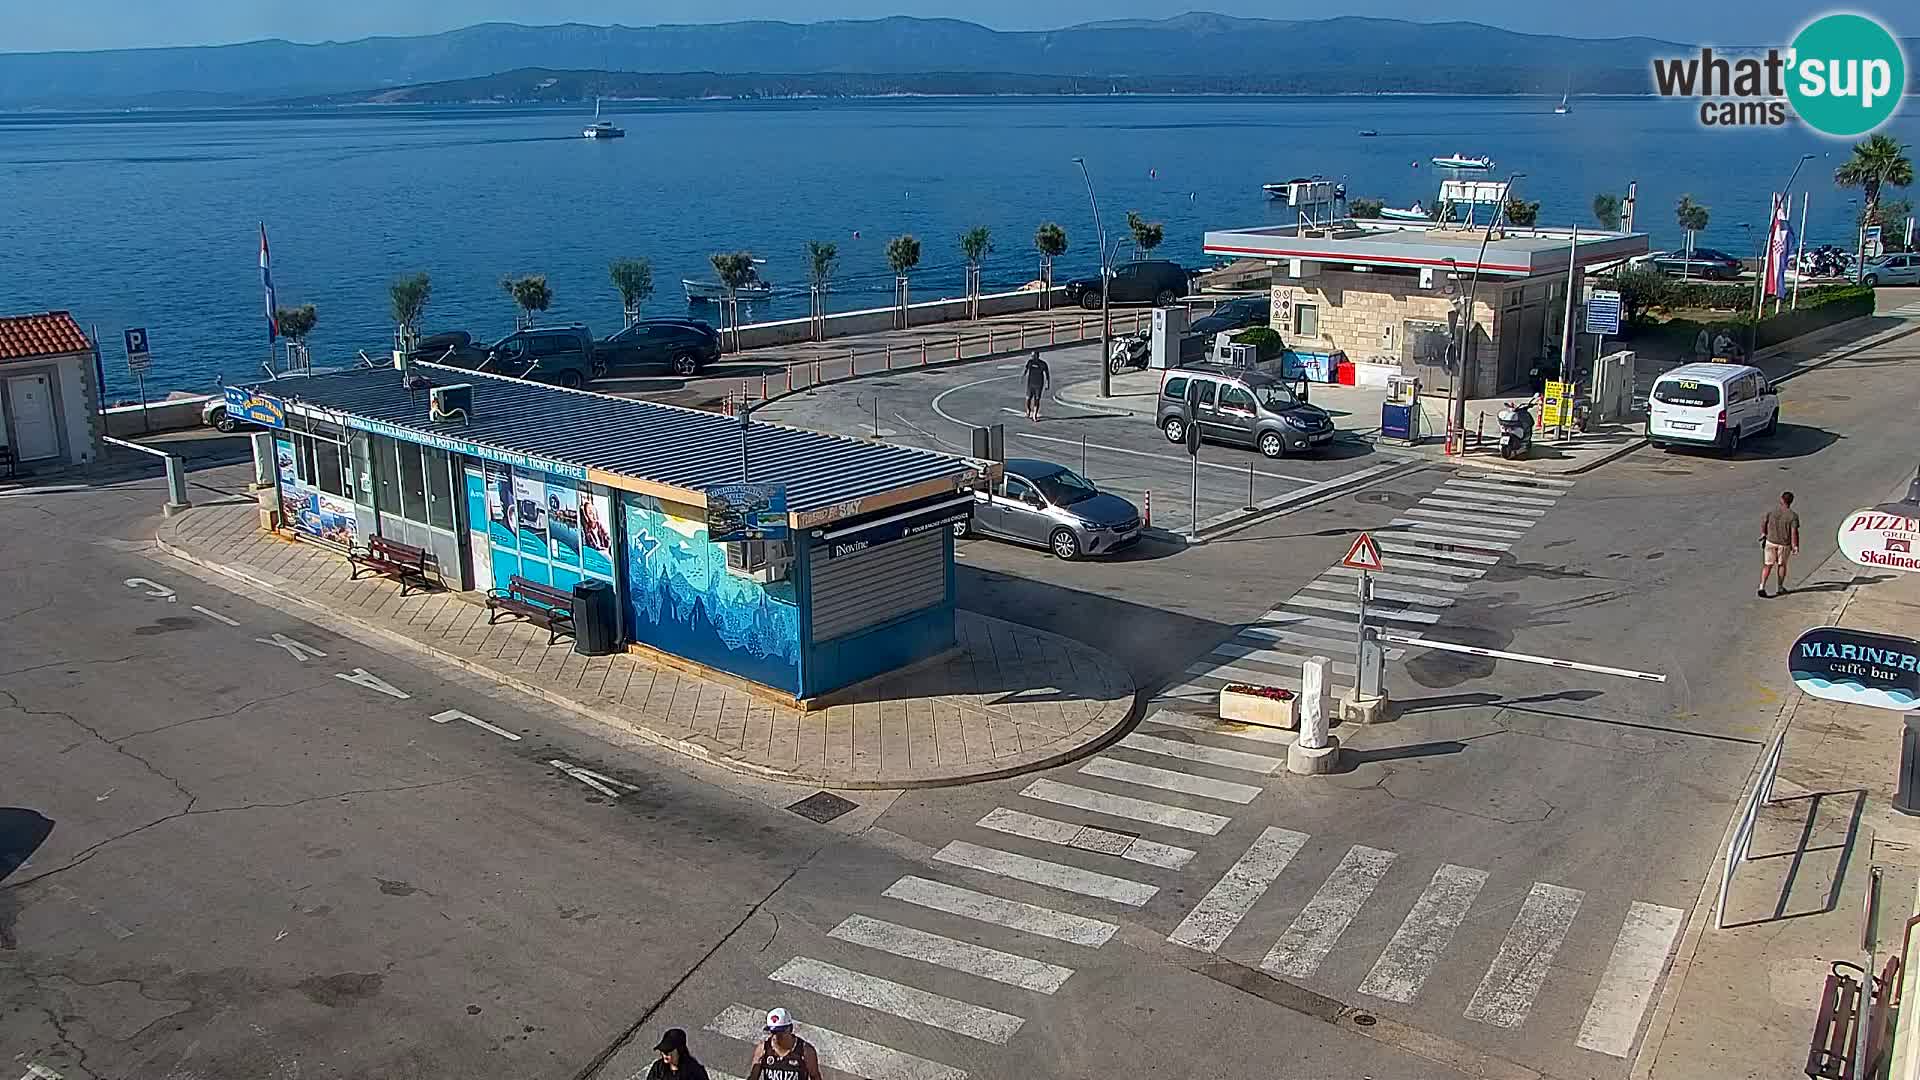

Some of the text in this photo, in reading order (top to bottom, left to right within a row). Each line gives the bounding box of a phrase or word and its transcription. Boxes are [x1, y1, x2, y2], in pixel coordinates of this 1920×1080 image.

[130, 332, 141, 350] P
[1680, 381, 1698, 390] TAXI
[394, 427, 435, 446] AUTOBUSNA
[435, 437, 468, 452] POSTAJA
[477, 446, 493, 458] BUS
[493, 449, 526, 465] STATION
[527, 458, 554, 473] TICKET
[555, 463, 582, 478] OFFICE
[1849, 515, 1920, 534] PIZZE
[1882, 530, 1918, 541] GRILL
[1800, 642, 1920, 674] MARINER
[1830, 663, 1898, 681] caffe bar
